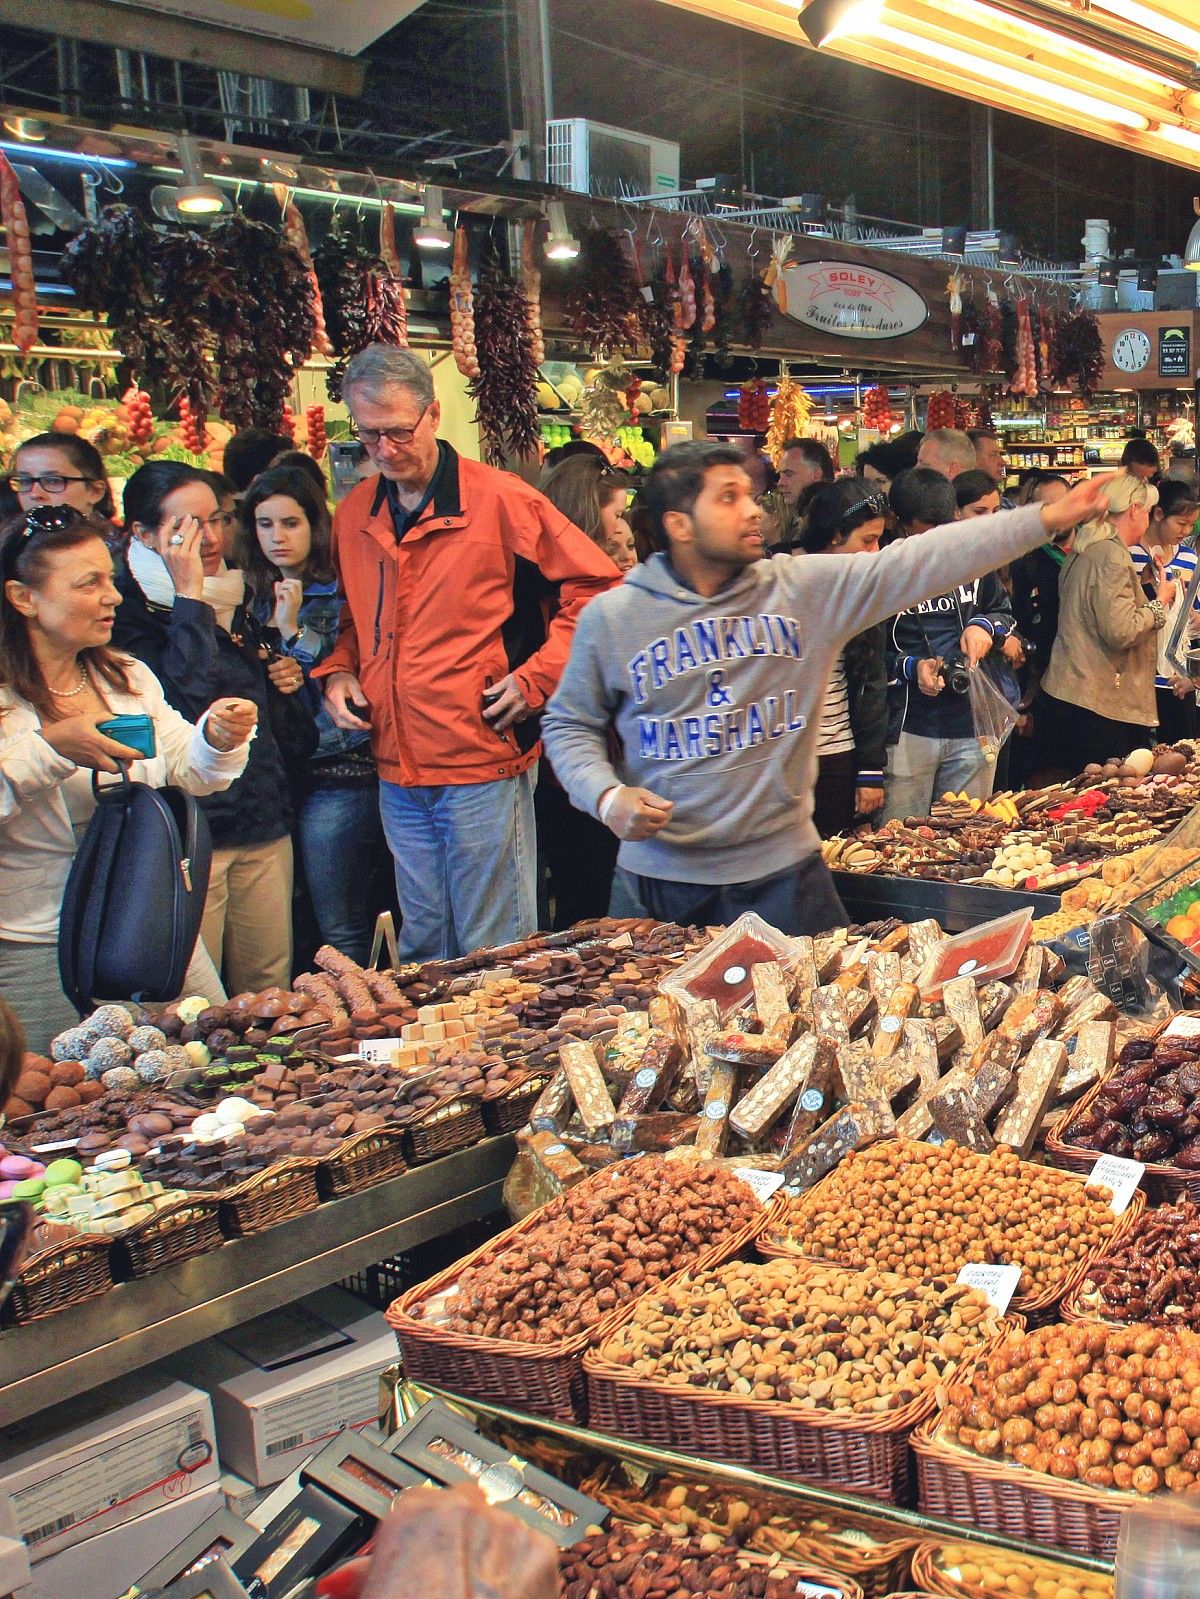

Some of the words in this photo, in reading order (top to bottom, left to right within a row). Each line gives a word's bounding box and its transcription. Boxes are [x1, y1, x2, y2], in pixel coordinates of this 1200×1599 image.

[830, 272, 876, 287] SOLEY
[628, 614, 804, 704] FRANKLIN
[706, 668, 736, 708] &
[638, 690, 807, 760] MARSHALL
